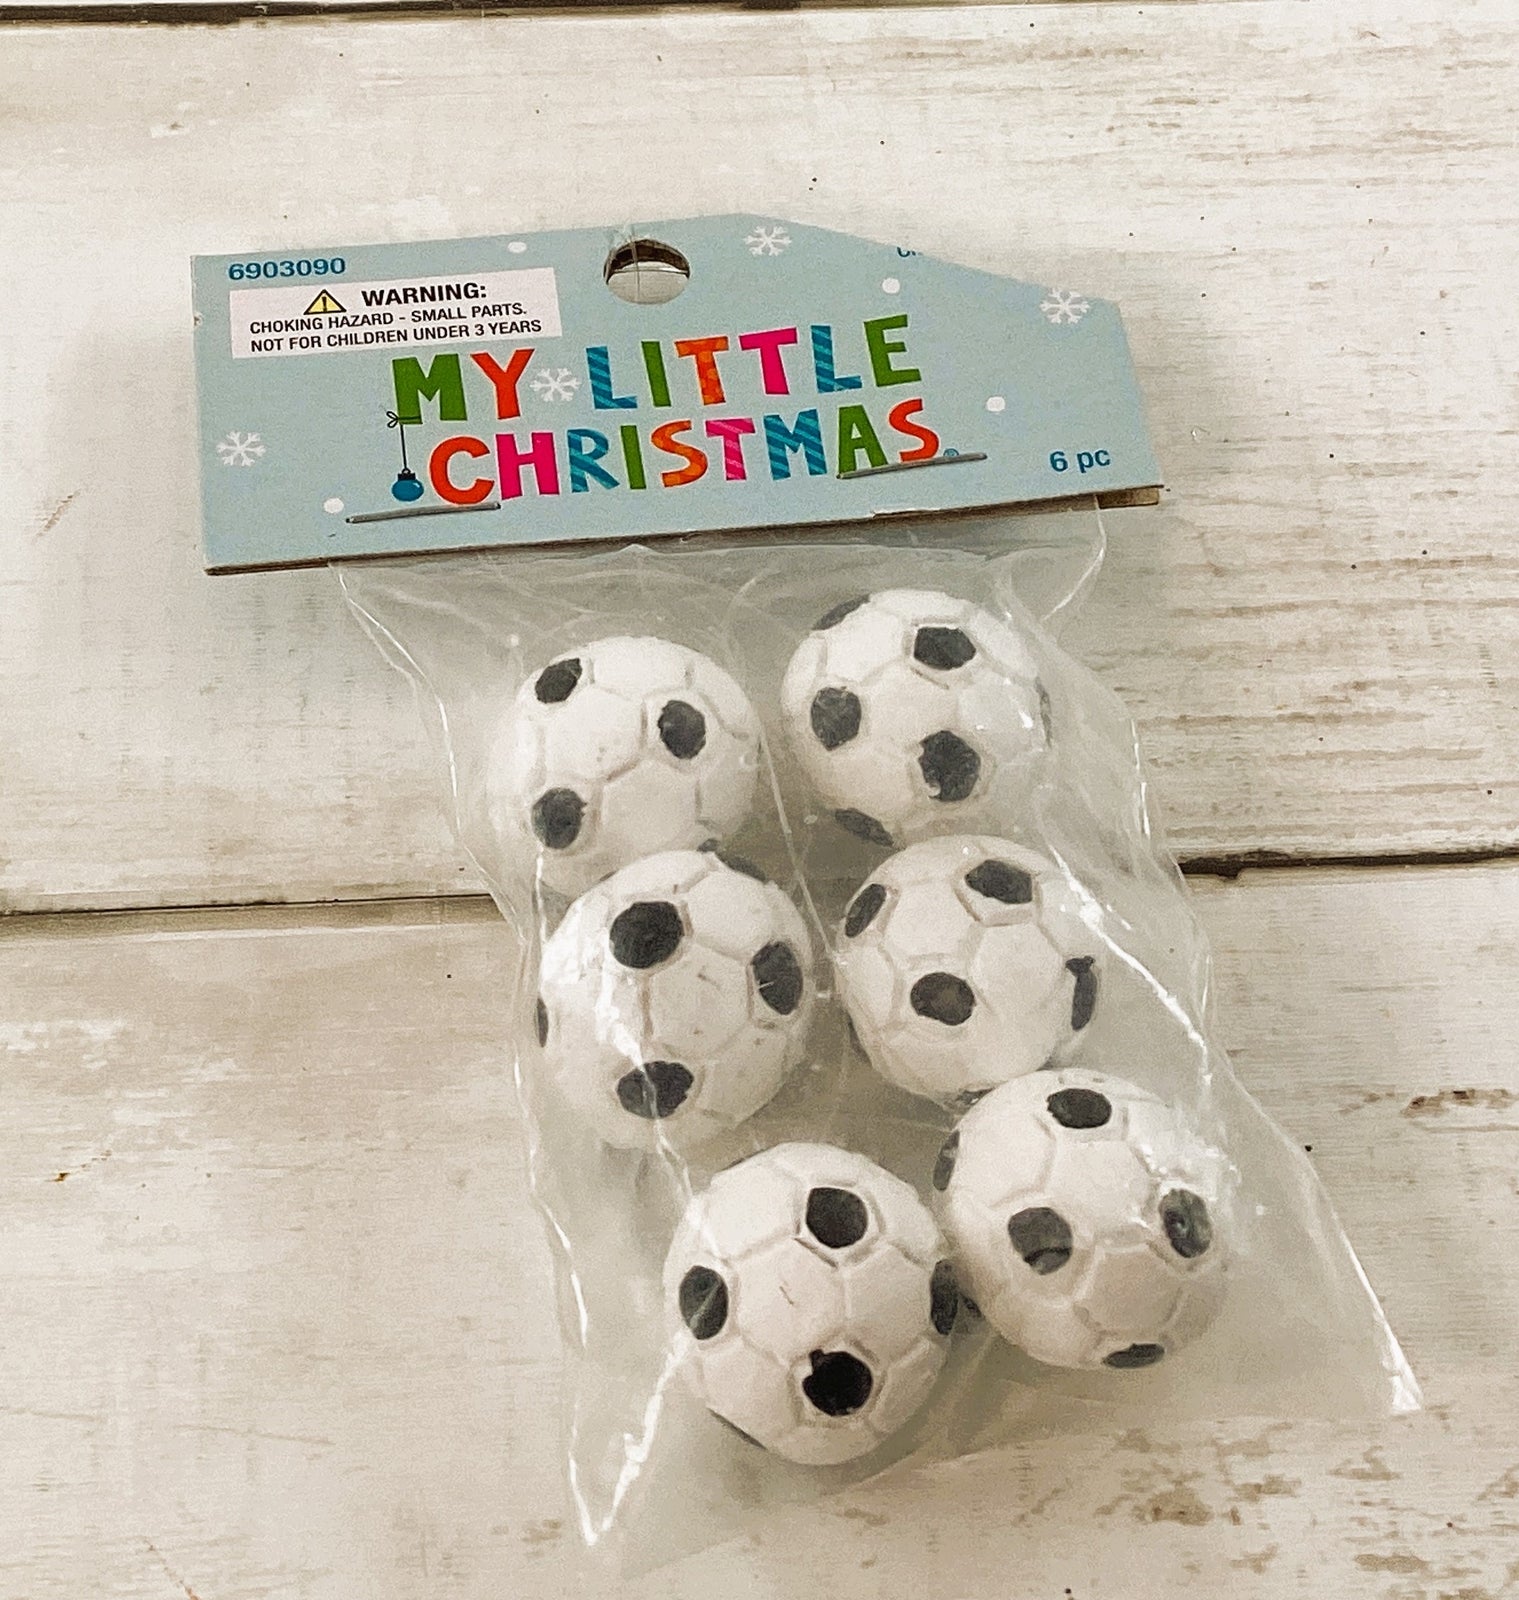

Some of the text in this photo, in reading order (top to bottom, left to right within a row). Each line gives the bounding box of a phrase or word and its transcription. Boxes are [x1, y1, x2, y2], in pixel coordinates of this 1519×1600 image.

[228, 257, 345, 280] 6903090
[361, 282, 487, 306] WARNING:
[250, 317, 323, 334] CHOKING
[329, 312, 393, 329] HAZARD
[411, 307, 467, 323] SMALL
[472, 302, 527, 318] PARTS.
[251, 319, 542, 352] NOT FOR CHILDREN UNDER 3 YEARS
[392, 314, 922, 425] MY LITTLE
[428, 398, 941, 506] CHRISTMAS
[1050, 449, 1111, 474] 6 pc
